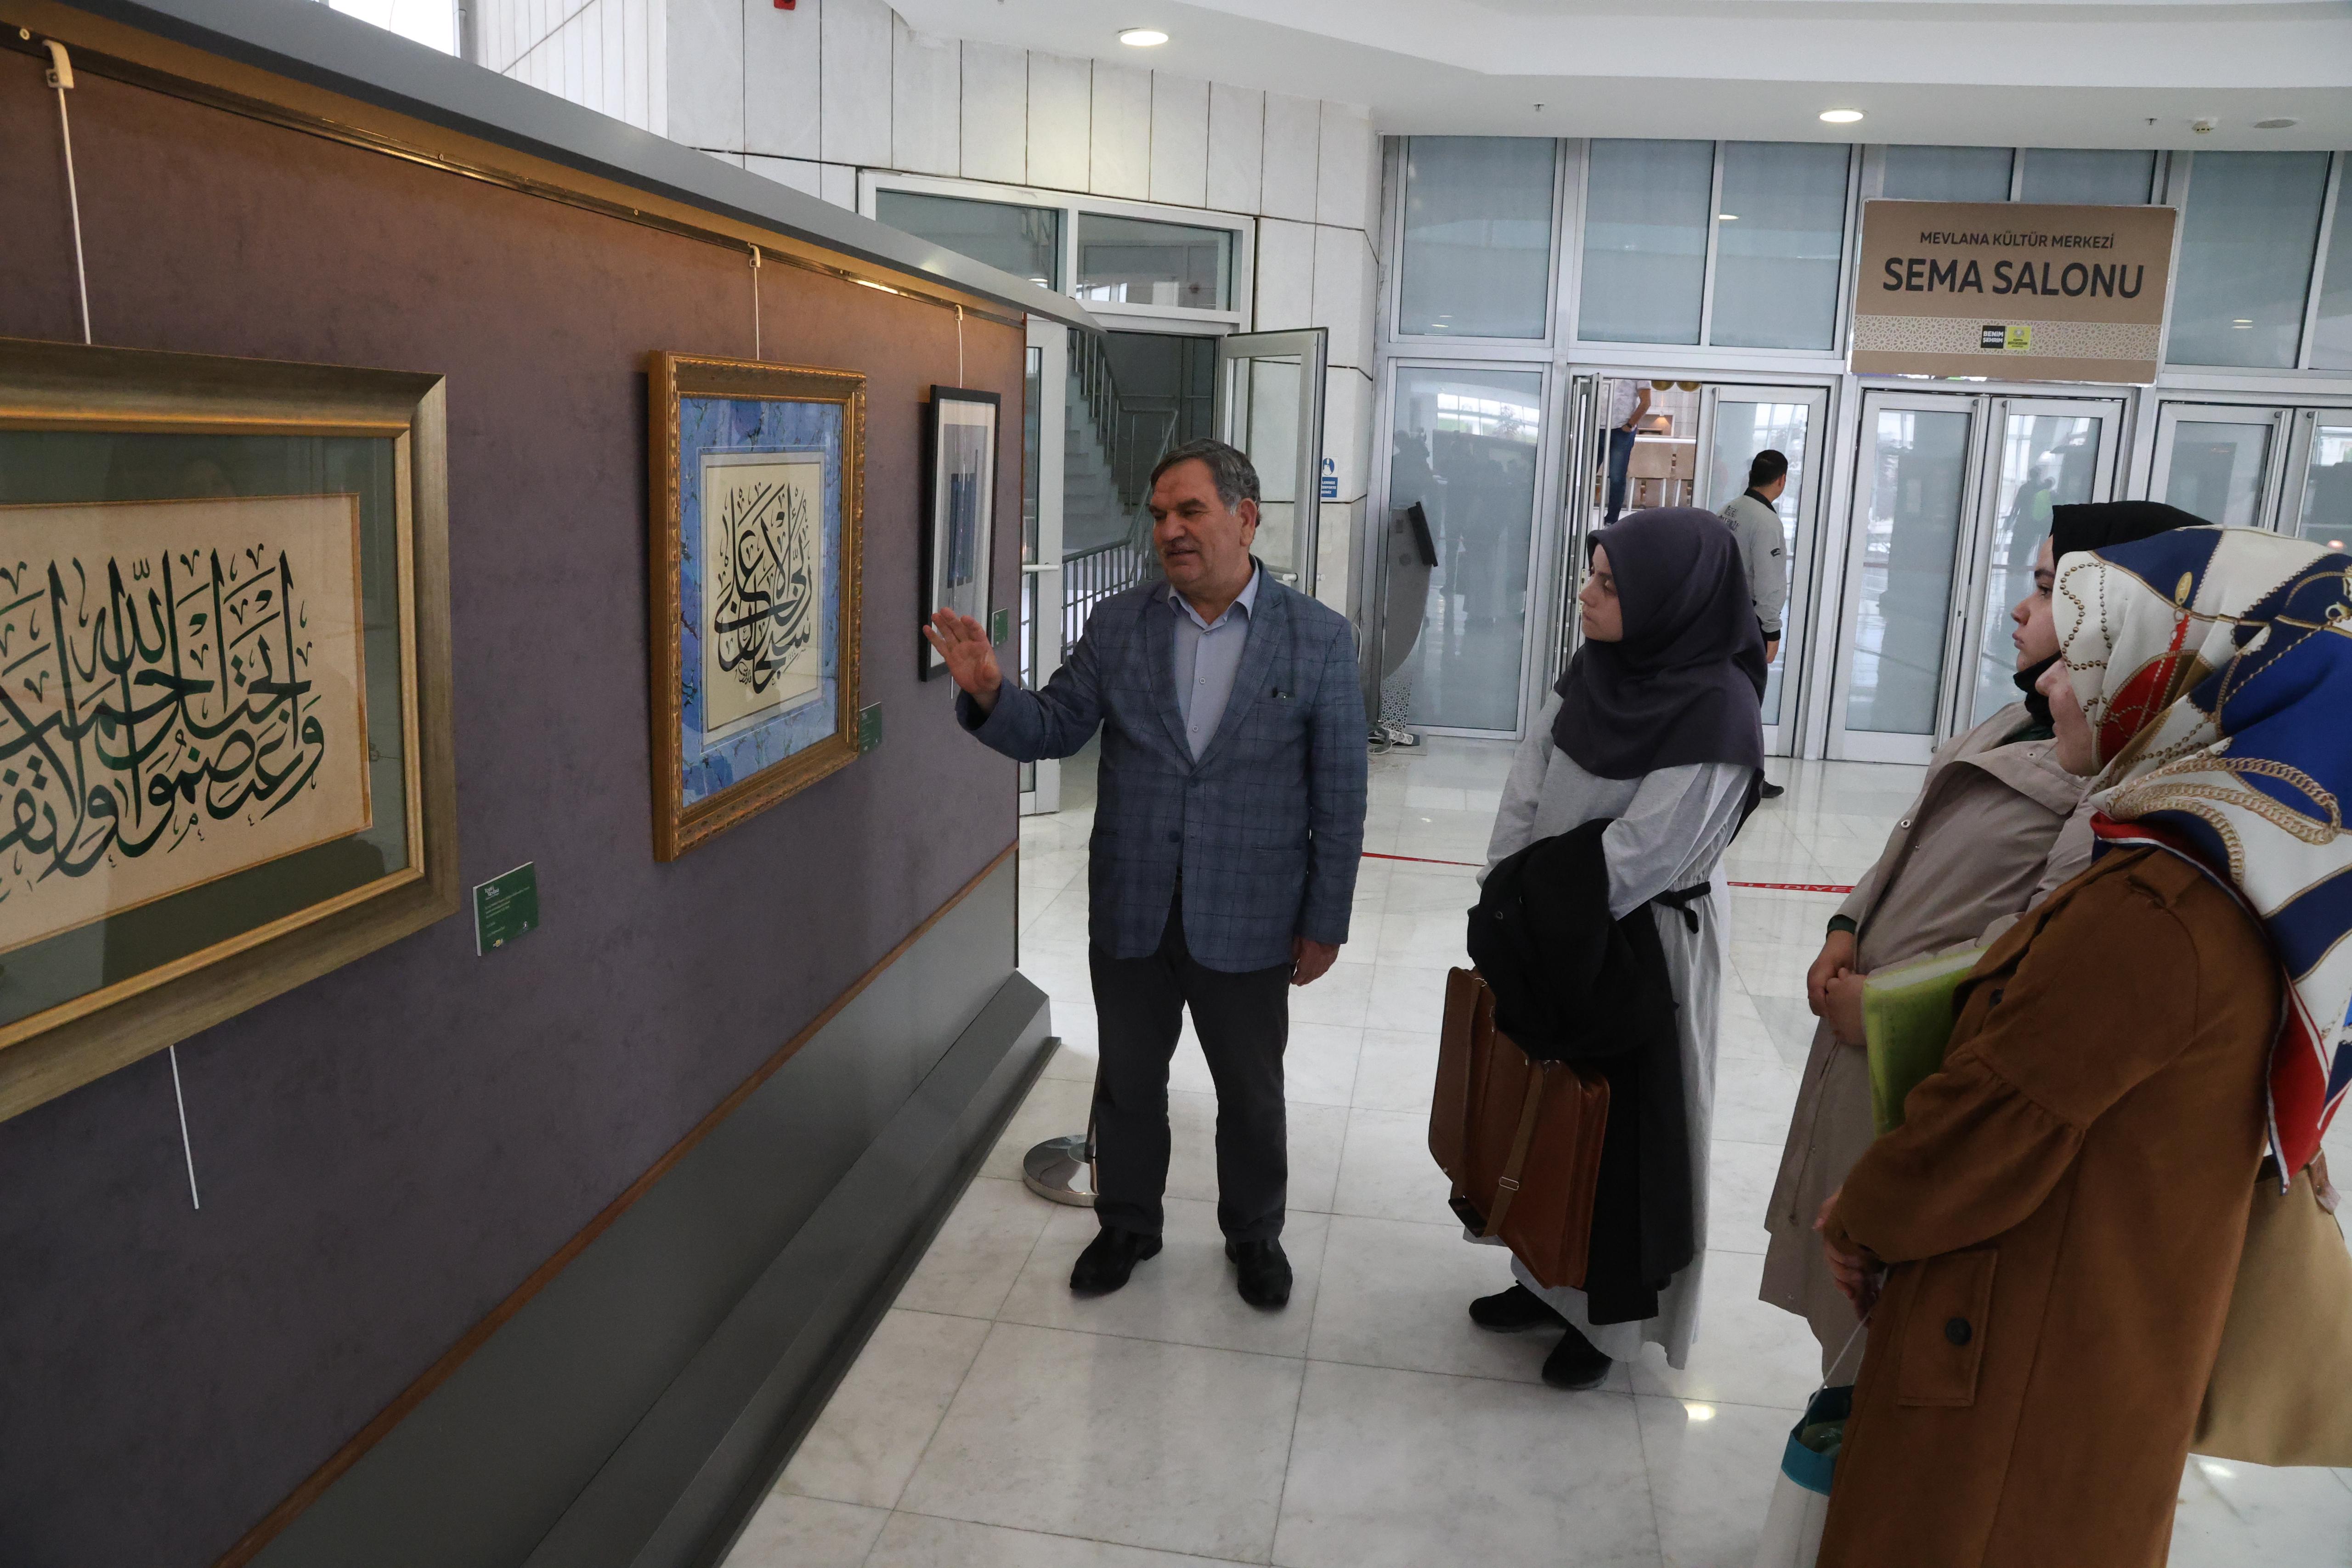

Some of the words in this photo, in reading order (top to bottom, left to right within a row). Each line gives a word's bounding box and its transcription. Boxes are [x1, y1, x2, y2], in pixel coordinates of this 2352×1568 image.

[1920, 232, 1989, 245] MEVLANA
[1993, 231, 2047, 247] KÜLTÜR
[2051, 233, 2114, 249] MERKEZİ
[1883, 257, 1984, 293] SEMA
[1992, 260, 2144, 299] SALONU
